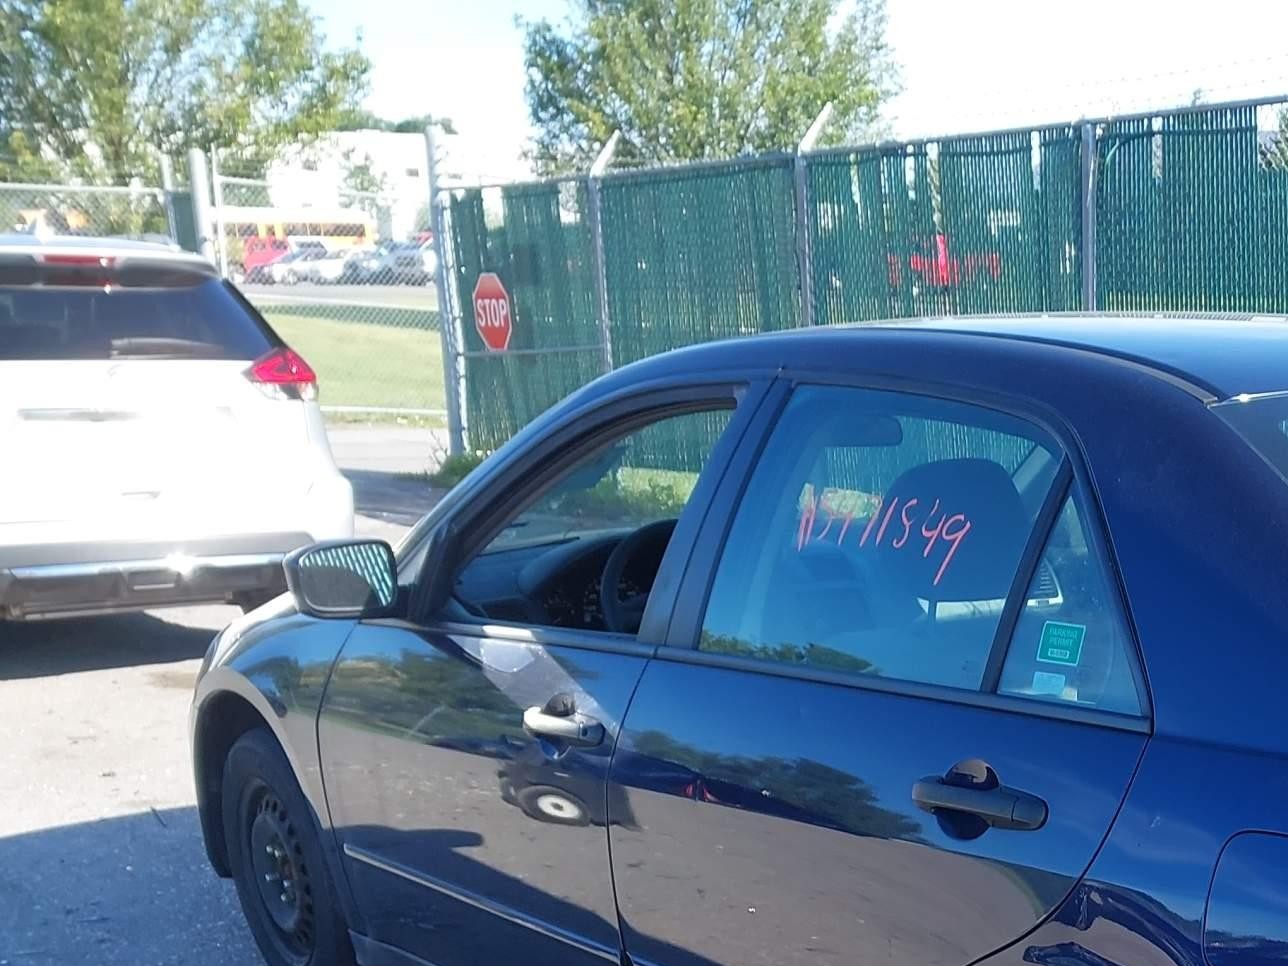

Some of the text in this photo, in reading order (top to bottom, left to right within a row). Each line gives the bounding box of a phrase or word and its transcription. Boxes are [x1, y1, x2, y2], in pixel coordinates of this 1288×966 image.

[477, 298, 507, 328] STOP
[1049, 627, 1078, 640] PARKING
[1048, 636, 1073, 647] PERMIT
